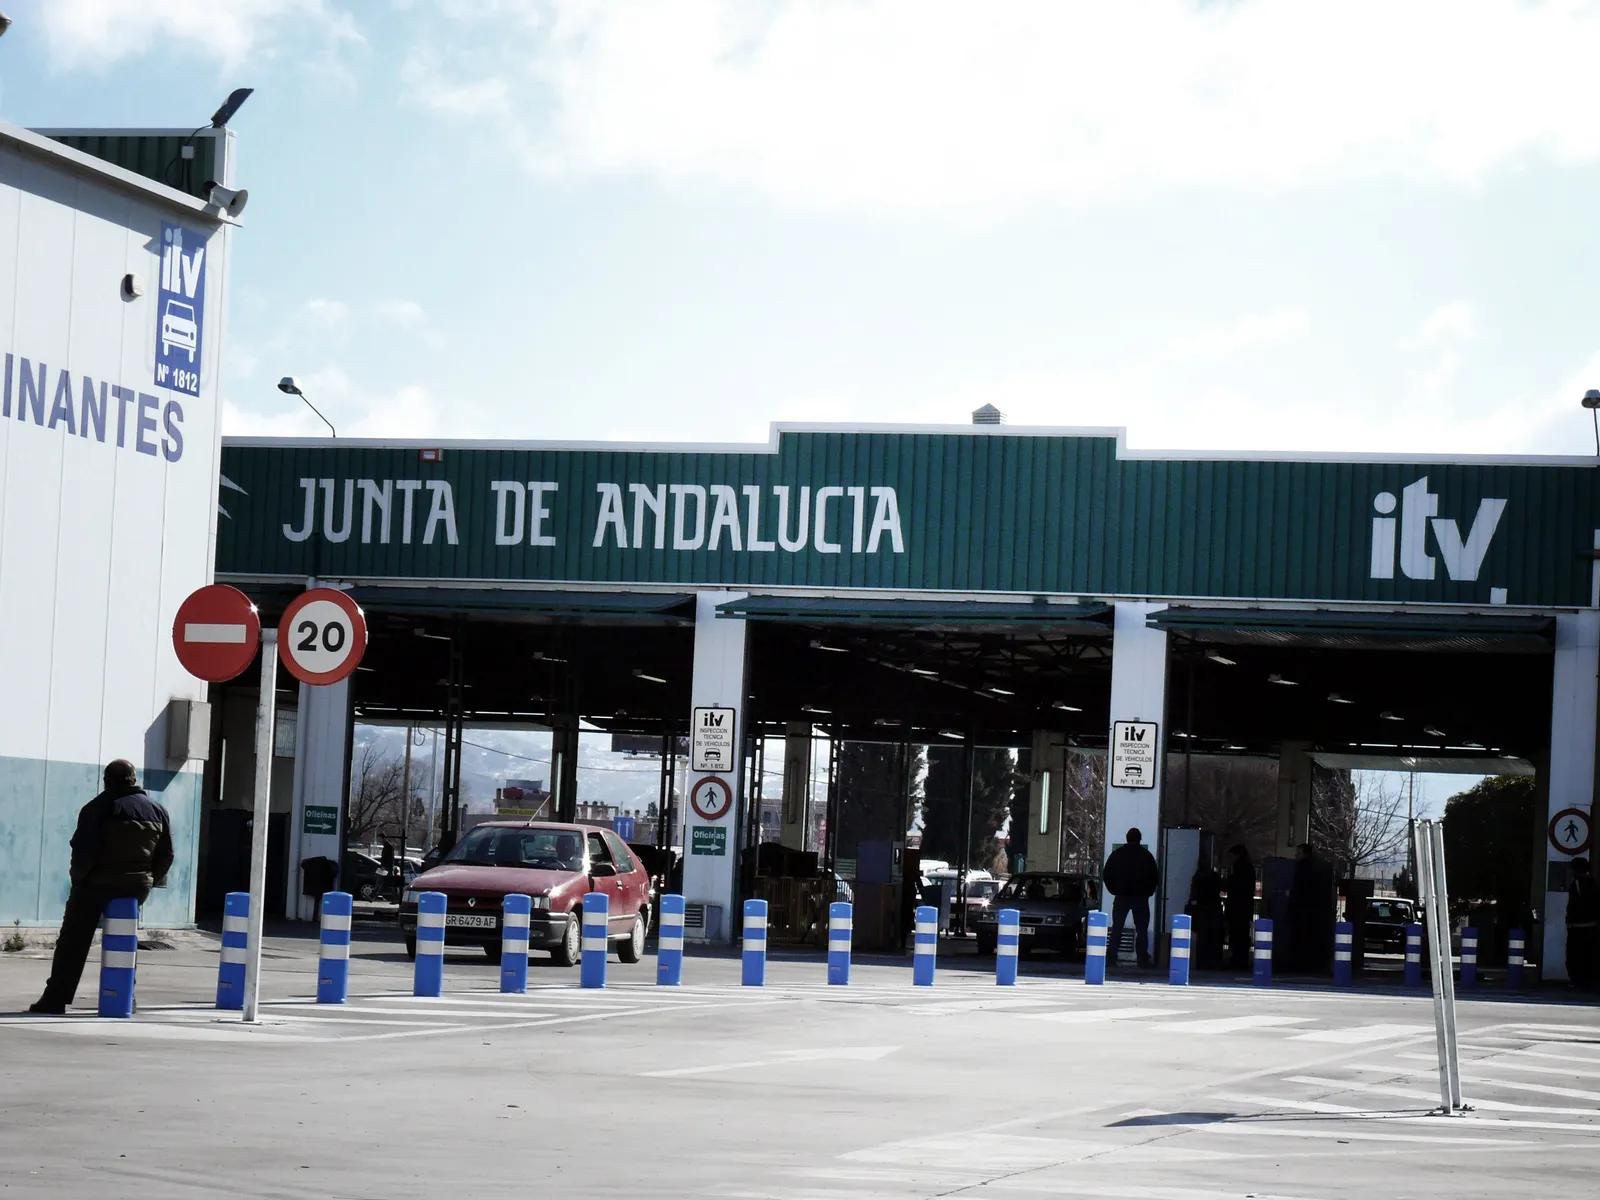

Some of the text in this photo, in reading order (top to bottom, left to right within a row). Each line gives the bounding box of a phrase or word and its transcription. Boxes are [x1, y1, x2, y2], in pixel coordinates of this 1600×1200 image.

[172, 368, 198, 392] 1812
[2, 352, 185, 463] INANTES
[282, 477, 905, 553] JUNTA DE ANDALUCIA
[297, 620, 346, 652] 20
[703, 711, 724, 727] itv
[1124, 725, 1146, 741] itv
[306, 810, 337, 819] Oficinas
[693, 831, 726, 840] Oficinas
